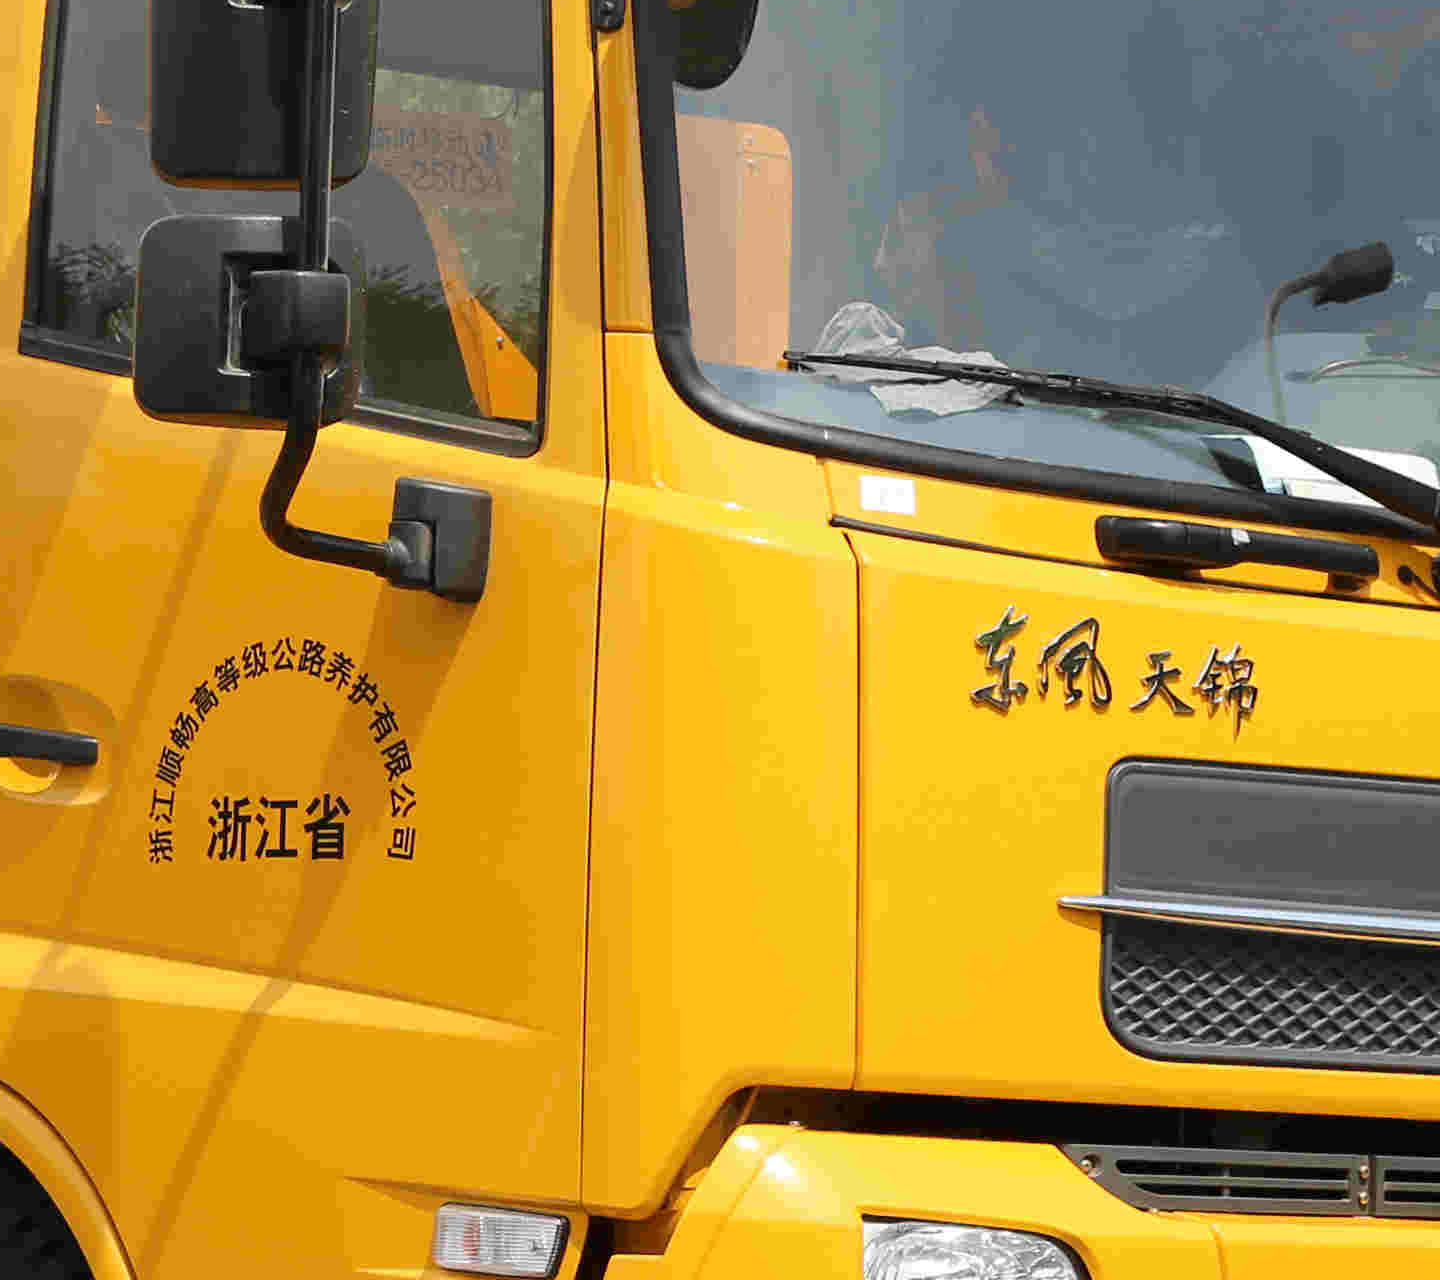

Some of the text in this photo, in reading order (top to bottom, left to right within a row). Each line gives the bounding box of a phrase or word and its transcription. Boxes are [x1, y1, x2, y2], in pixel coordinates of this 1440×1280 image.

[148, 636, 417, 863] 浙江顺畅高等级公路养护有限公司
[206, 792, 351, 862] 浙江省
